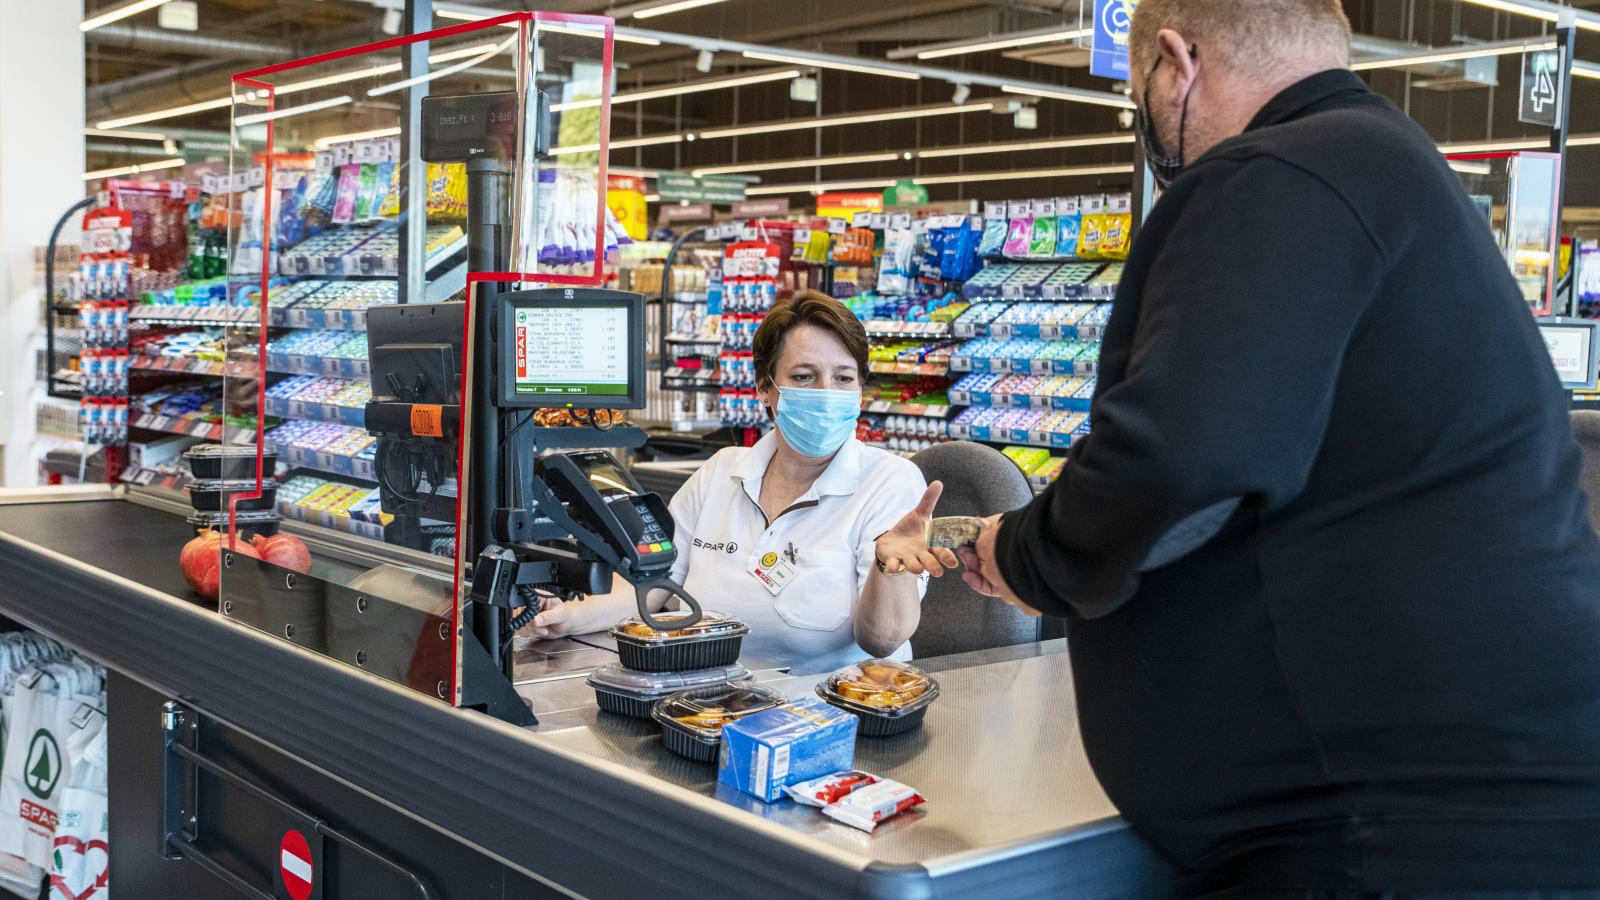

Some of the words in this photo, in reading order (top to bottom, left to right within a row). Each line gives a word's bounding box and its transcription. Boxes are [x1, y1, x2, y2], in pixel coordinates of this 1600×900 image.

[1531, 52, 1554, 113] 4
[518, 327, 526, 368] SPAR
[692, 538, 725, 551] SPAR
